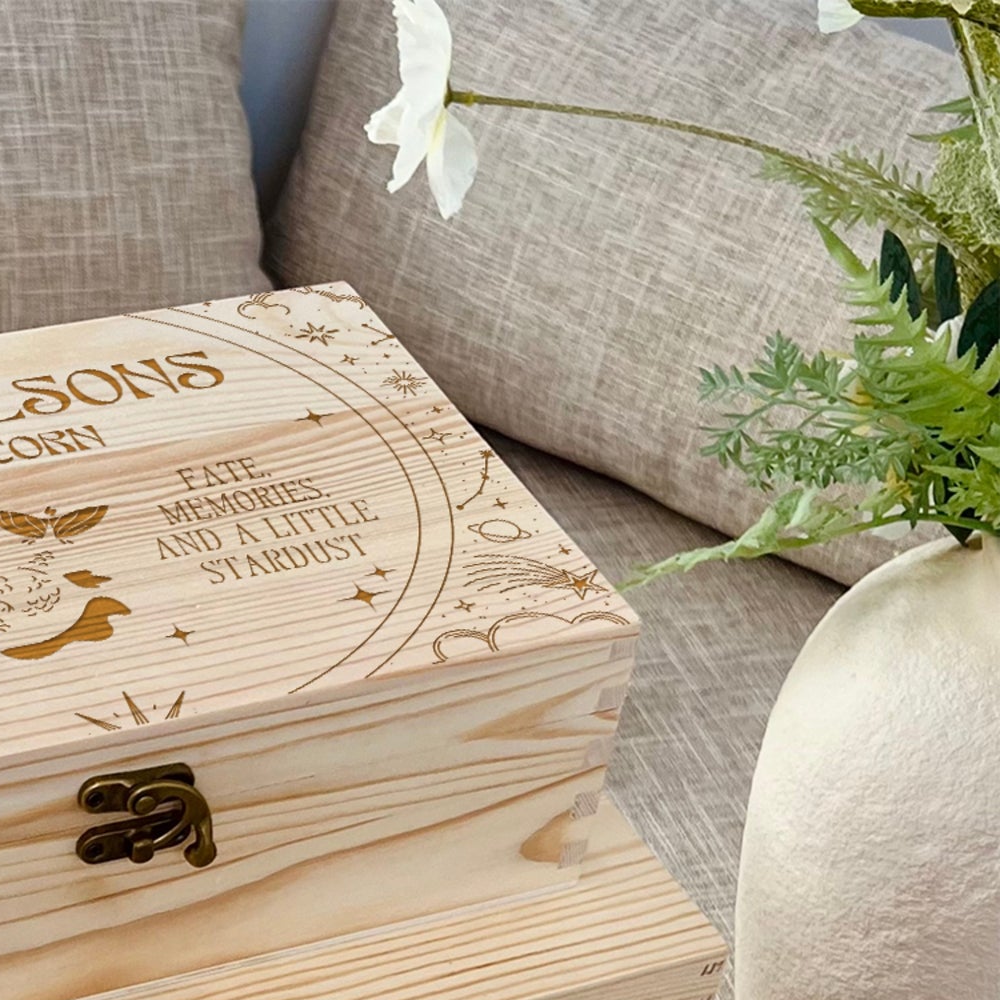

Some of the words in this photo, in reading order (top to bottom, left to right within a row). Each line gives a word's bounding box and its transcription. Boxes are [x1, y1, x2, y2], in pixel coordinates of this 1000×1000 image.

[155, 529, 222, 560] AND
[236, 523, 261, 545] A
[262, 500, 379, 539] LITTLE
[200, 534, 367, 584] STARDUST
